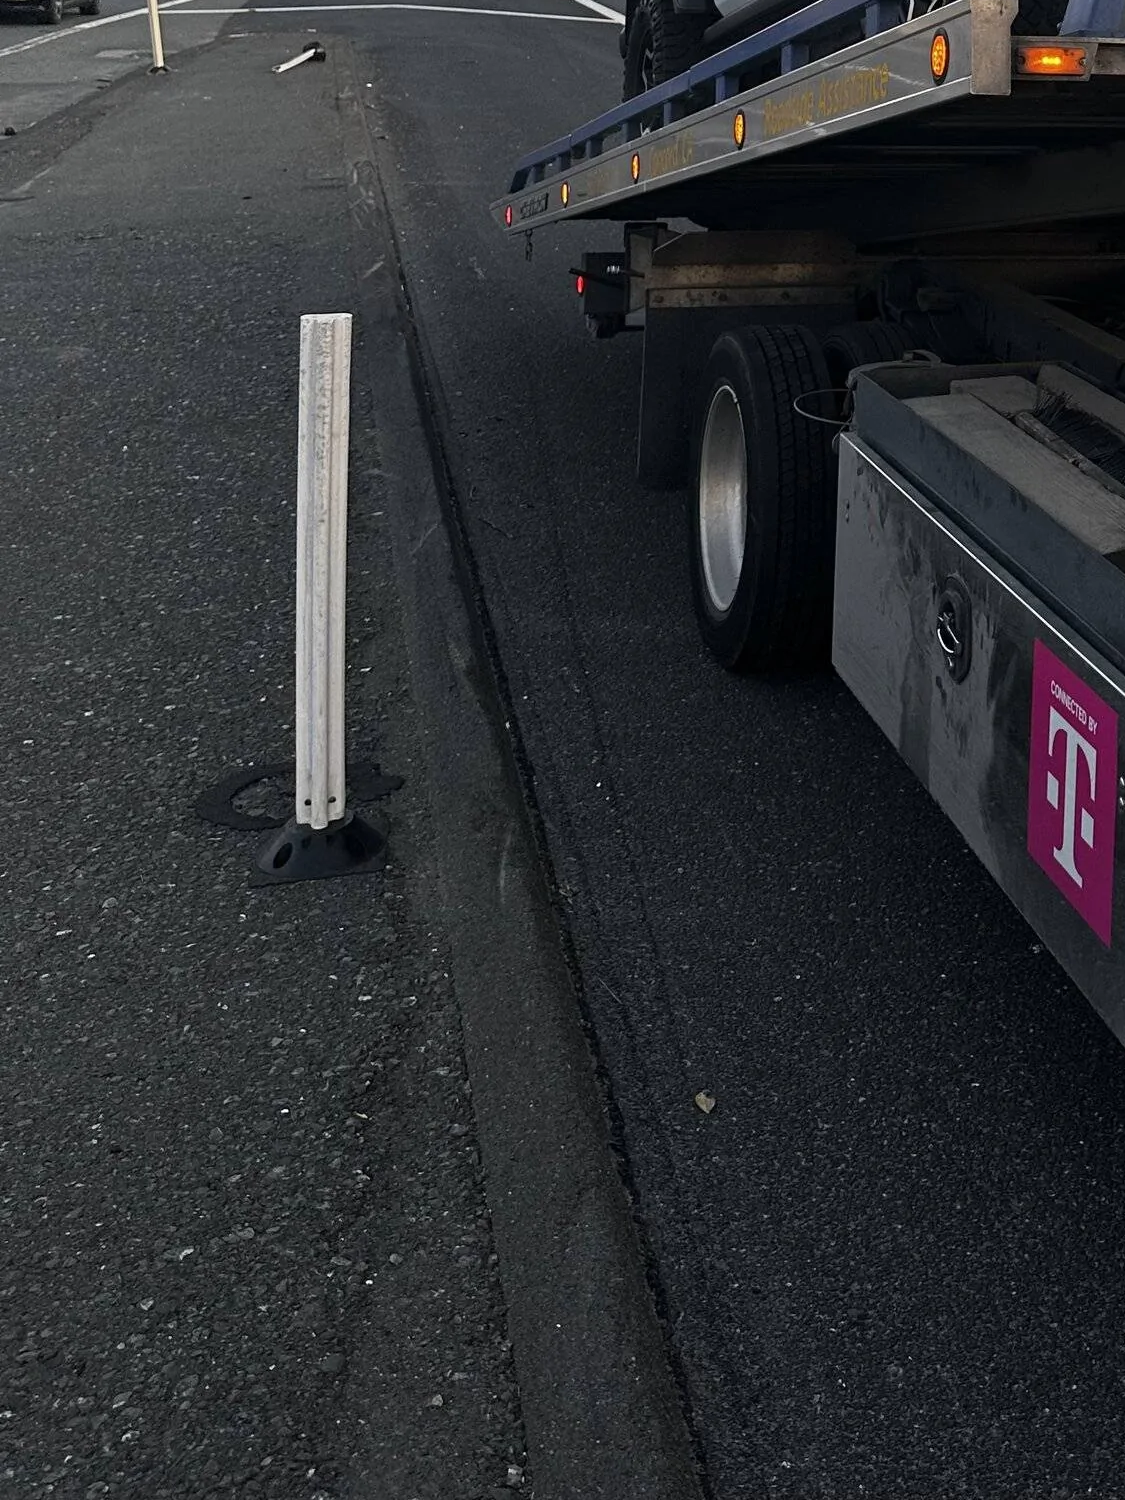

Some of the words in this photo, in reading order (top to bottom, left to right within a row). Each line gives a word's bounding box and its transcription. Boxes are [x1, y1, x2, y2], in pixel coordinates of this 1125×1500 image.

[818, 62, 889, 117] Assistance
[1051, 680, 1087, 725] CONNECTED
[1088, 715, 1098, 735] BY
